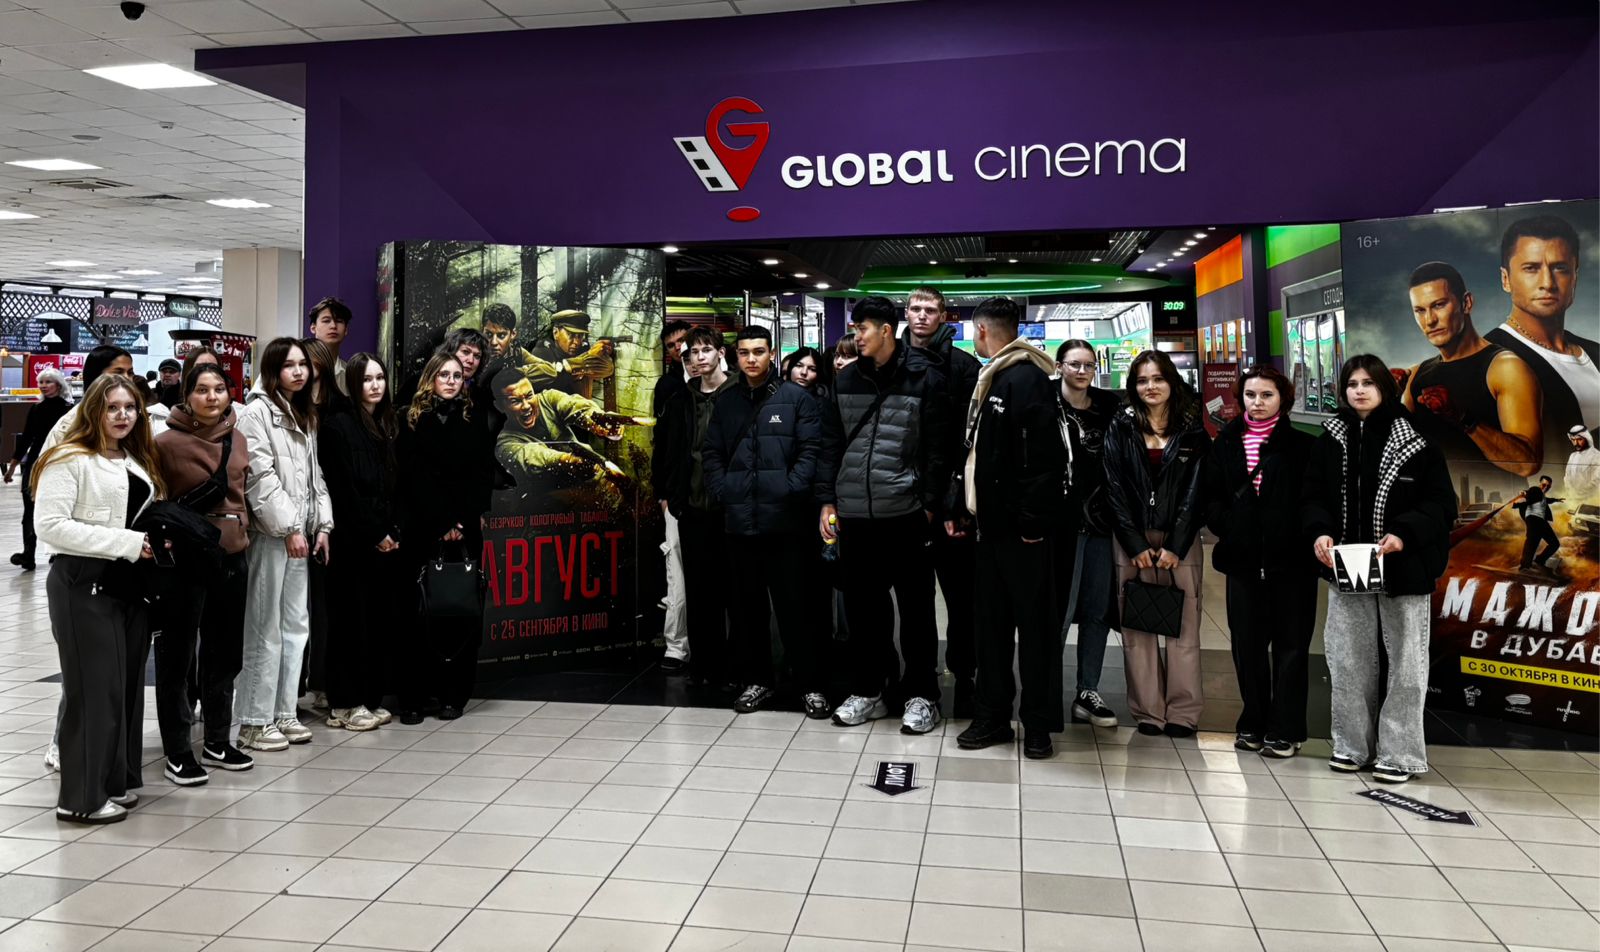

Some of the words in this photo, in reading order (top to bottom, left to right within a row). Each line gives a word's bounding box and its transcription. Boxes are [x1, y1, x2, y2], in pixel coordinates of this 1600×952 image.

[974, 137, 1186, 181] cinema
[1356, 235, 1380, 249] 16+
[489, 514, 524, 529] БЕЗРУКОВ
[481, 531, 624, 608] АВГУСТ
[490, 623, 497, 640] С
[501, 620, 515, 640] 25
[519, 615, 569, 637] СЕНТЯБРЯ
[572, 614, 579, 632] В
[582, 612, 608, 631] КИНО
[1470, 629, 1488, 649] В
[1468, 661, 1477, 671] С
[1480, 662, 1496, 674] 30
[1499, 665, 1557, 684] ОКТЯБРЯ
[1561, 674, 1569, 685] В
[884, 763, 907, 787] ЛИФТ
[1370, 790, 1459, 820] ЛЕСТНИЦА
